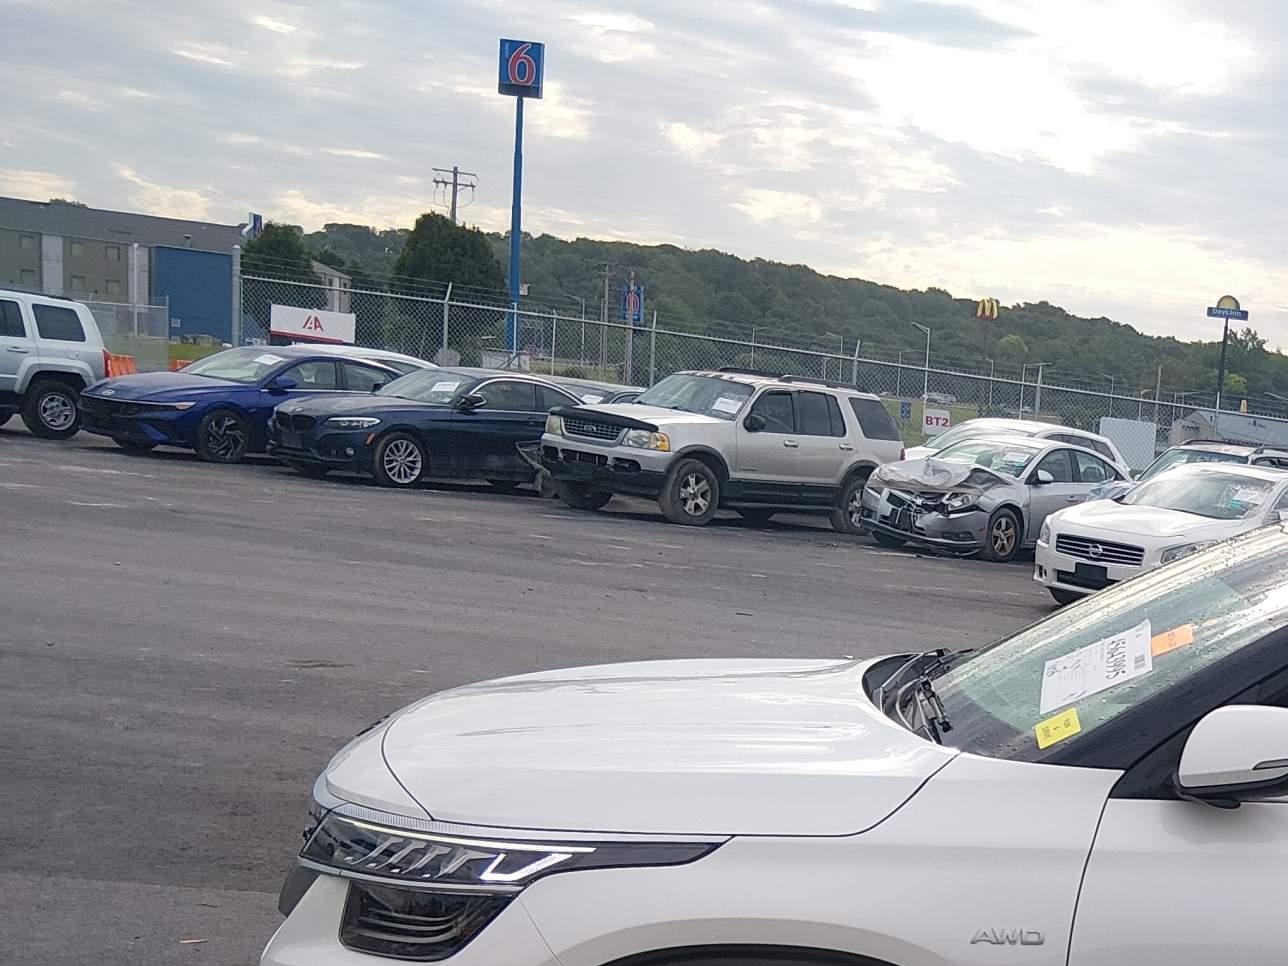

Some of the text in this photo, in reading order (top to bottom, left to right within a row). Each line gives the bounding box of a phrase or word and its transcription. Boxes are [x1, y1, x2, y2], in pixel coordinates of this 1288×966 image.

[508, 43, 536, 86] 6
[926, 416, 950, 428] BT2
[970, 928, 1045, 946] AWD
